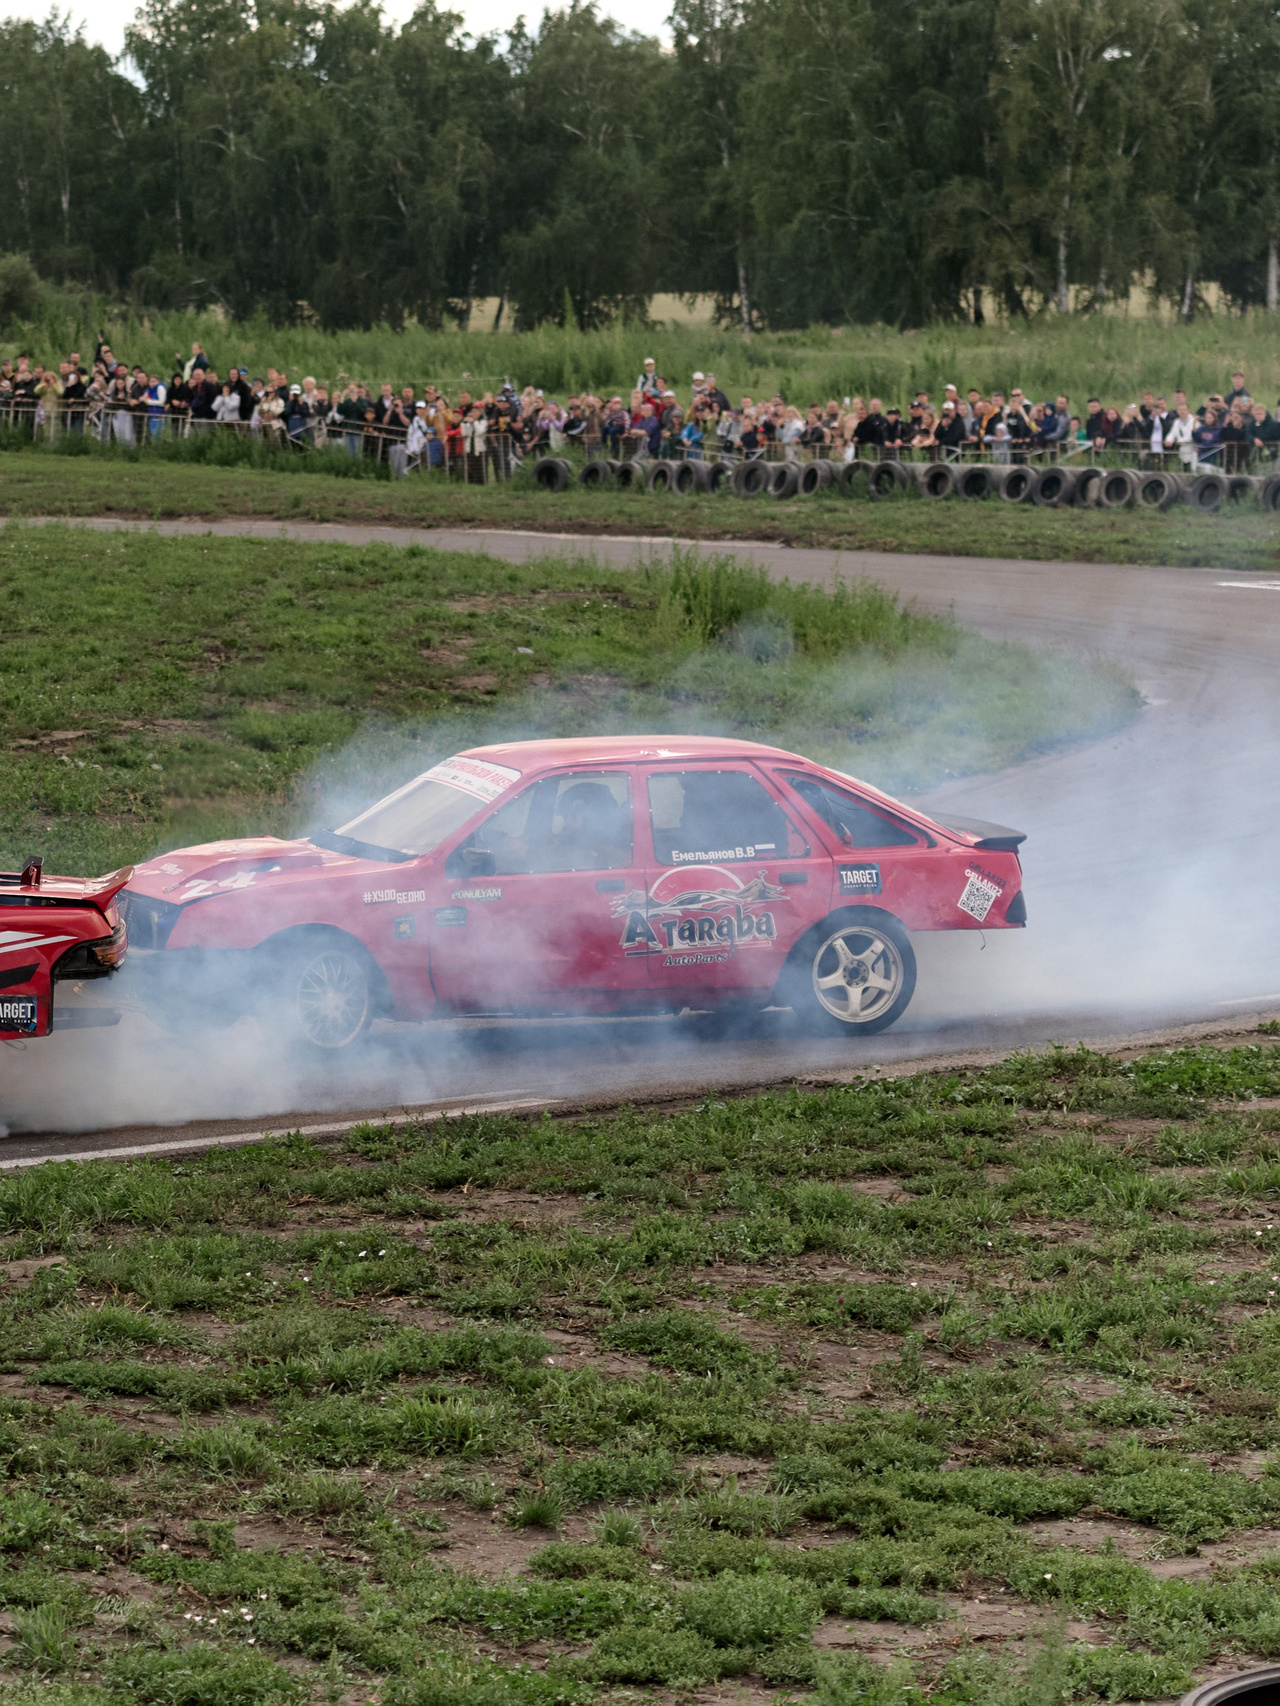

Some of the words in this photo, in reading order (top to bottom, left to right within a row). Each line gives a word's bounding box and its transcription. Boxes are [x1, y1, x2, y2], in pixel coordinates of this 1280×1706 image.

[671, 849, 735, 862] Емельянов
[840, 869, 878, 885] TARGET
[180, 871, 257, 900] 24
[451, 888, 502, 900] PONULYAM
[664, 952, 729, 967] AutoParts
